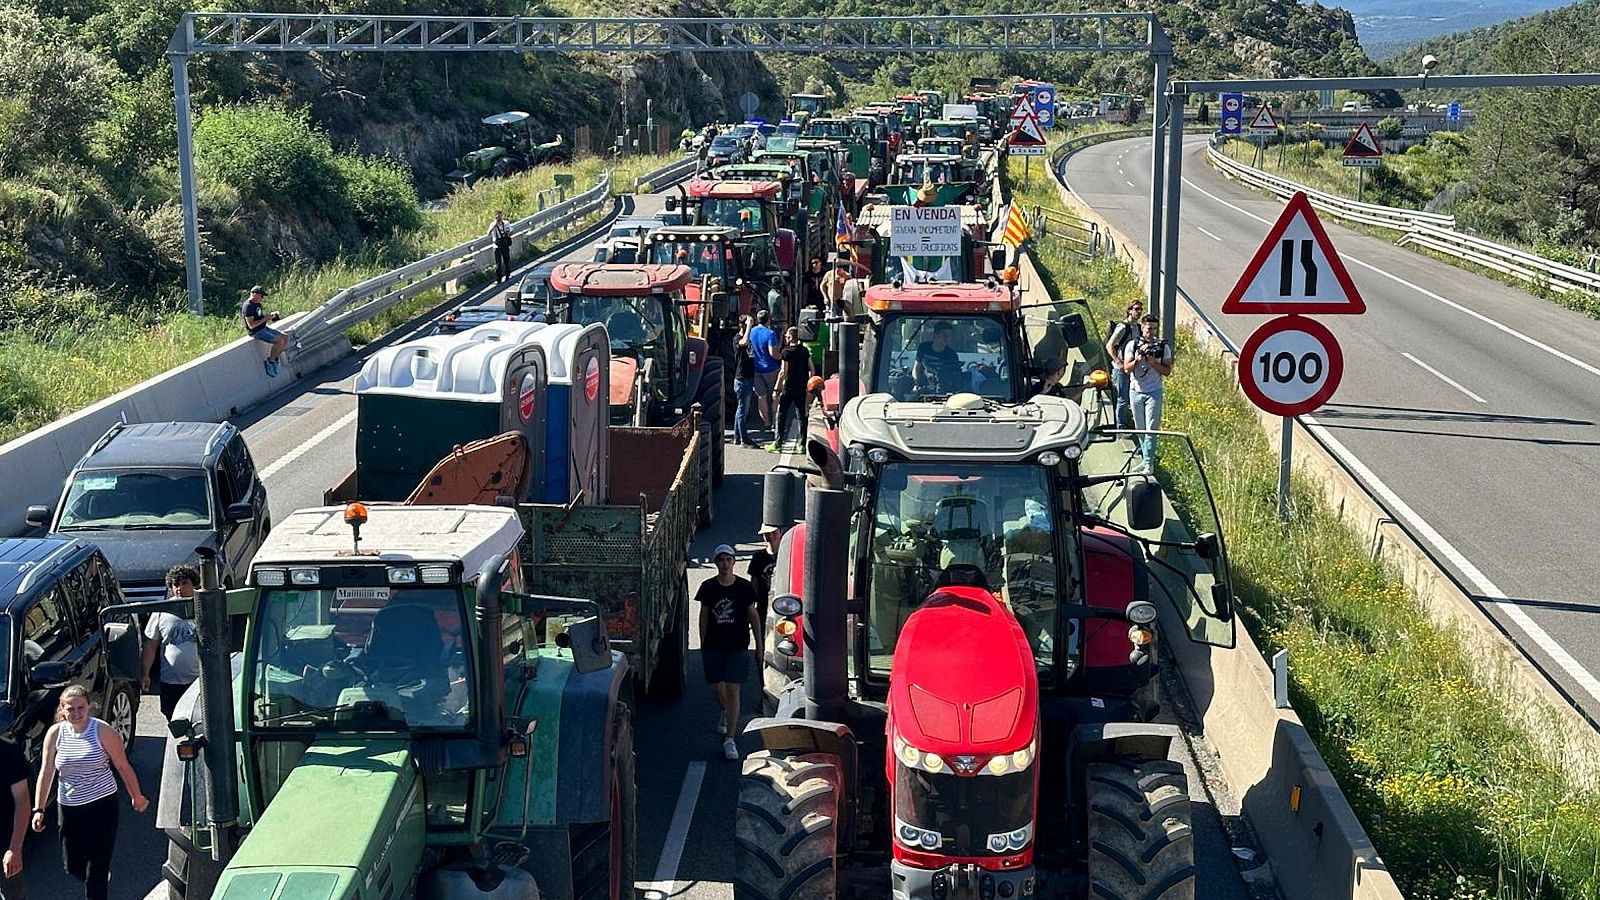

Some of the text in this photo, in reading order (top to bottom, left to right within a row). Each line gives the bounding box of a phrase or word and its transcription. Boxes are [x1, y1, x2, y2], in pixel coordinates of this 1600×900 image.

[895, 208, 957, 220] EN VENDA
[1259, 351, 1323, 384] 100
